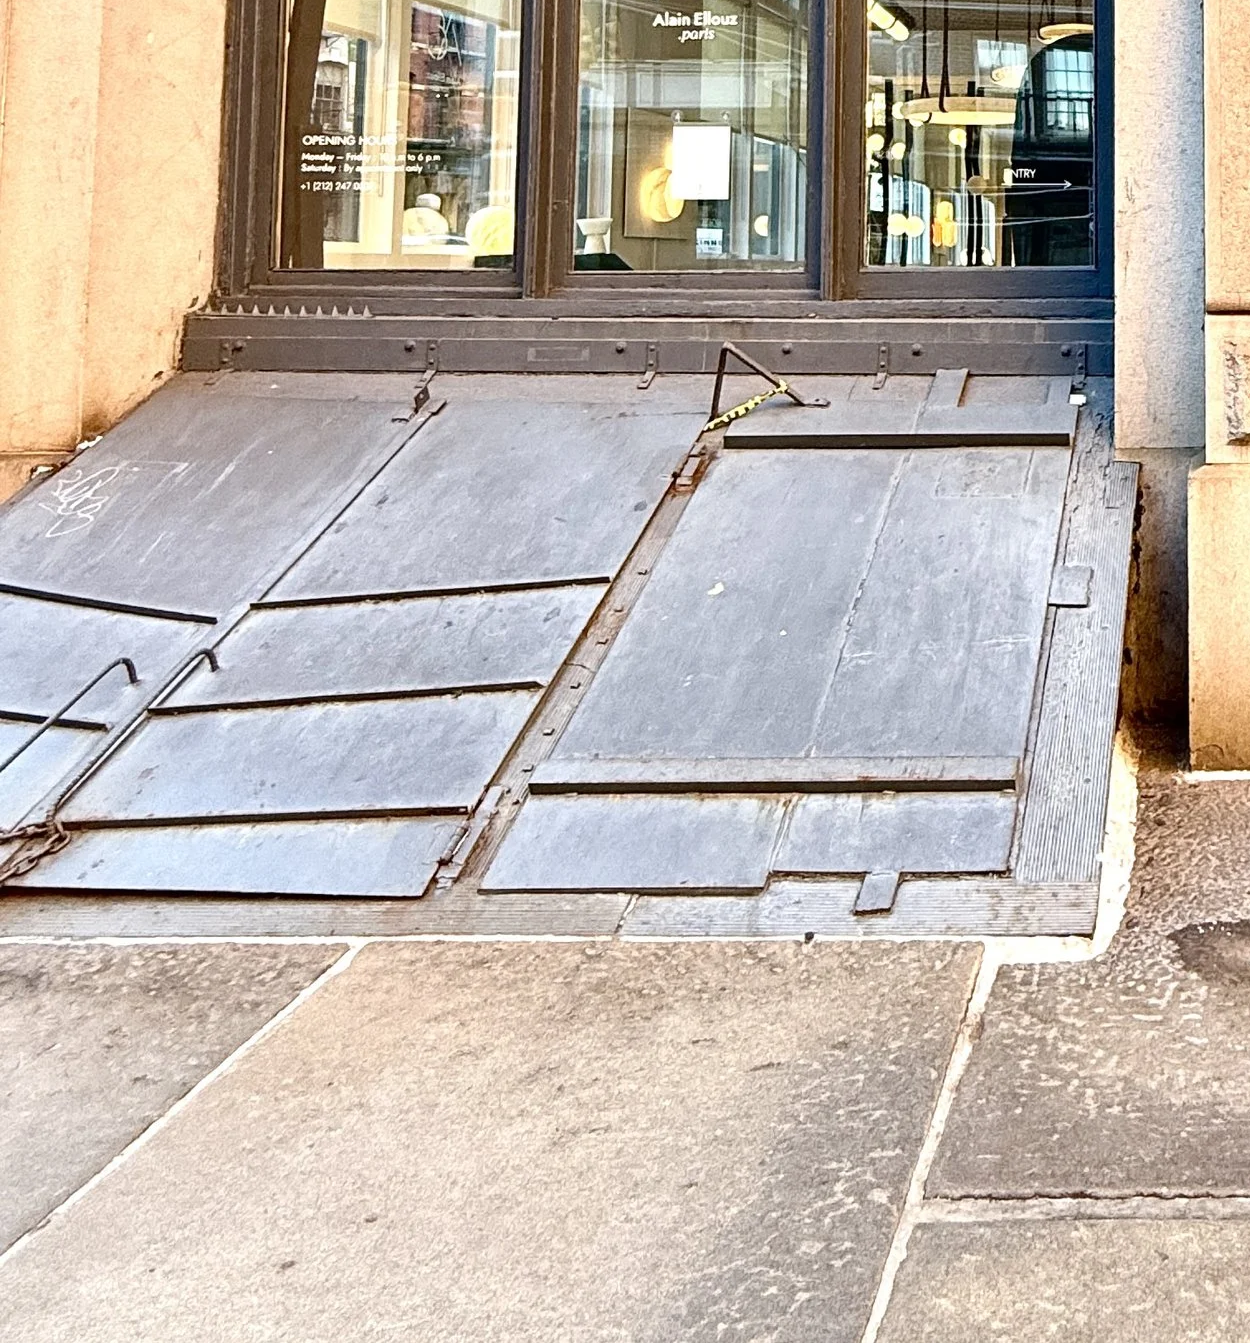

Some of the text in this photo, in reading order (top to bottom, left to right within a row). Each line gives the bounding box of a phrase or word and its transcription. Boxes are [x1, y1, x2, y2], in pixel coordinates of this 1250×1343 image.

[652, 11, 738, 27] Alain Ellouz
[302, 135, 397, 146] OPENING HOU
[301, 152, 334, 163] Monday
[407, 153, 415, 162] to
[417, 153, 424, 162] 6
[300, 163, 337, 175] Saturday
[343, 163, 355, 174] By
[1004, 168, 1036, 178] NTRY
[300, 181, 310, 191] +1
[313, 180, 333, 192] (212)
[335, 180, 351, 191] 247
